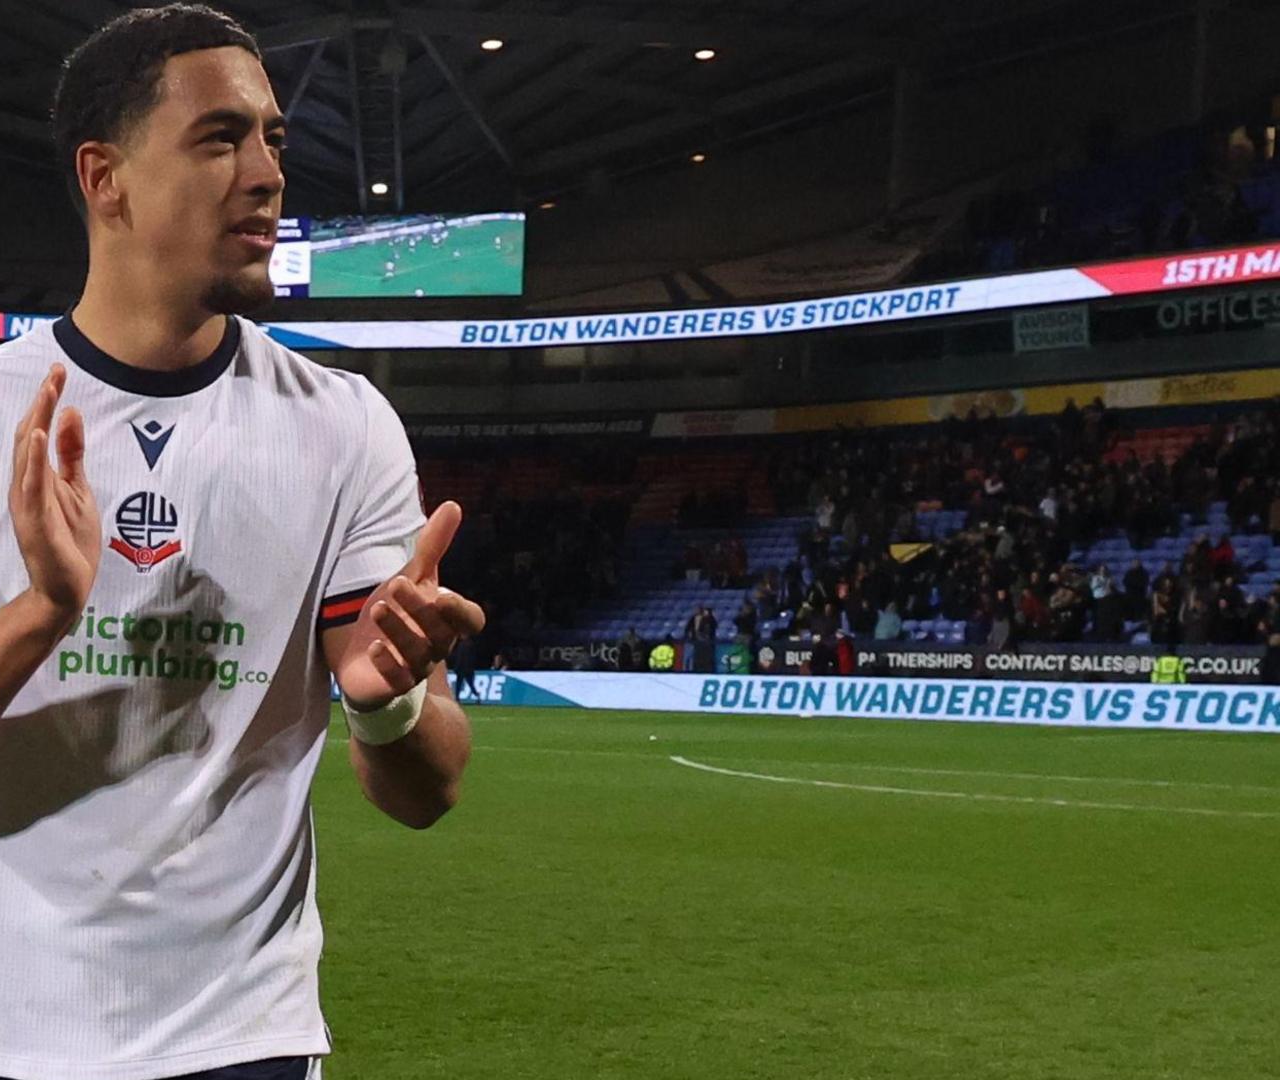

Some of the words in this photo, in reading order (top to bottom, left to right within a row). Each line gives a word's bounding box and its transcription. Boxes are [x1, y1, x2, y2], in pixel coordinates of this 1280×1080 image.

[1161, 255, 1239, 285] 15TH
[460, 321, 568, 344] BOLTON
[575, 308, 755, 340] WANDERERS
[763, 307, 796, 329] VS
[801, 287, 961, 326] STOCKPORT
[67, 606, 245, 646] ictorian
[858, 652, 973, 670] PATNERSHIPS
[985, 653, 1068, 671] CONTACT
[699, 679, 827, 711] BOLTON
[836, 681, 1075, 720] WANDERERS
[1083, 688, 1137, 722] VS
